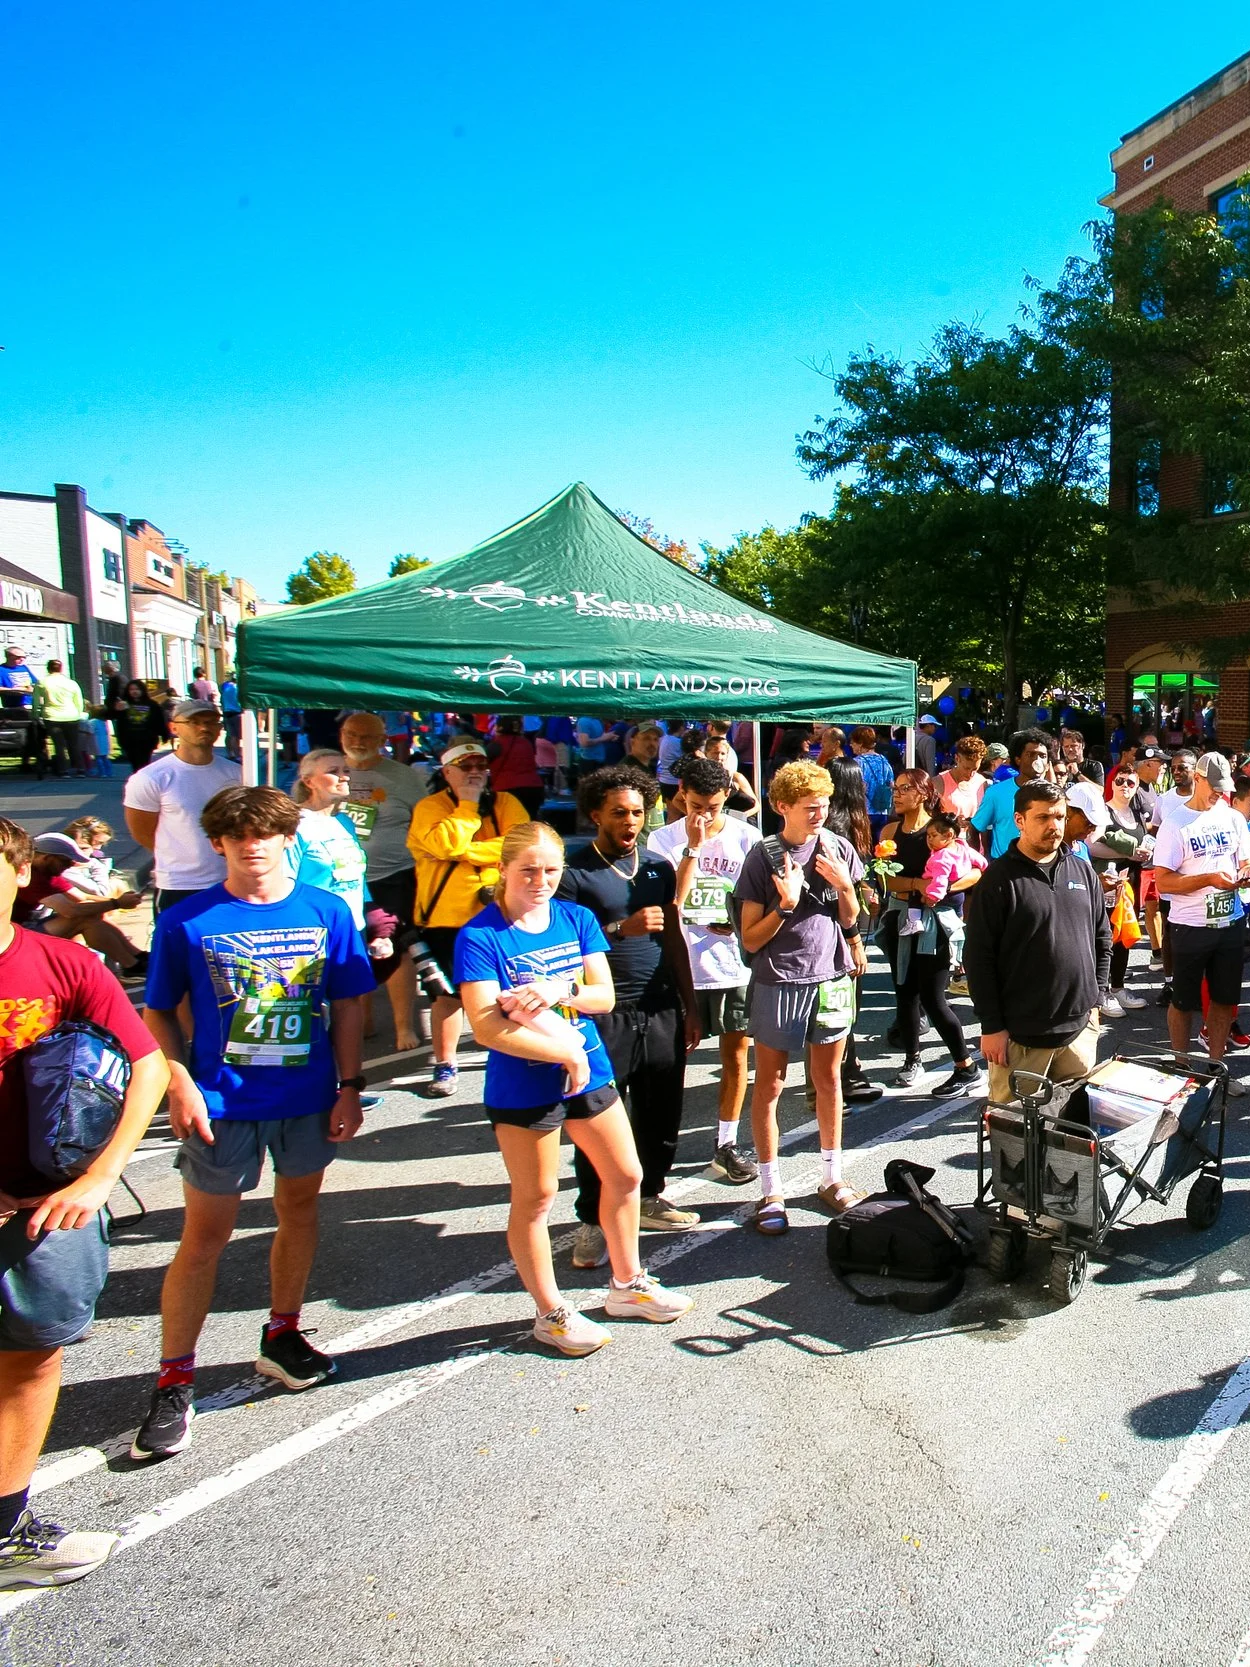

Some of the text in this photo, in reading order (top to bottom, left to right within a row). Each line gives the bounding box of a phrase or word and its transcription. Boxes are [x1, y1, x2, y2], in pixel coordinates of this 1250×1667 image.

[1, 580, 43, 615] BISTRO
[570, 591, 775, 629] Kentlands
[576, 608, 779, 634] COMMUNITY FOUNDATION
[561, 669, 781, 697] KENTLANDS.ORG
[342, 810, 367, 826] 02
[690, 887, 726, 906] 879
[253, 943, 318, 956] LAKELANDS
[279, 957, 296, 969] 5K
[827, 990, 852, 1008] 501
[244, 1013, 303, 1040] 419
